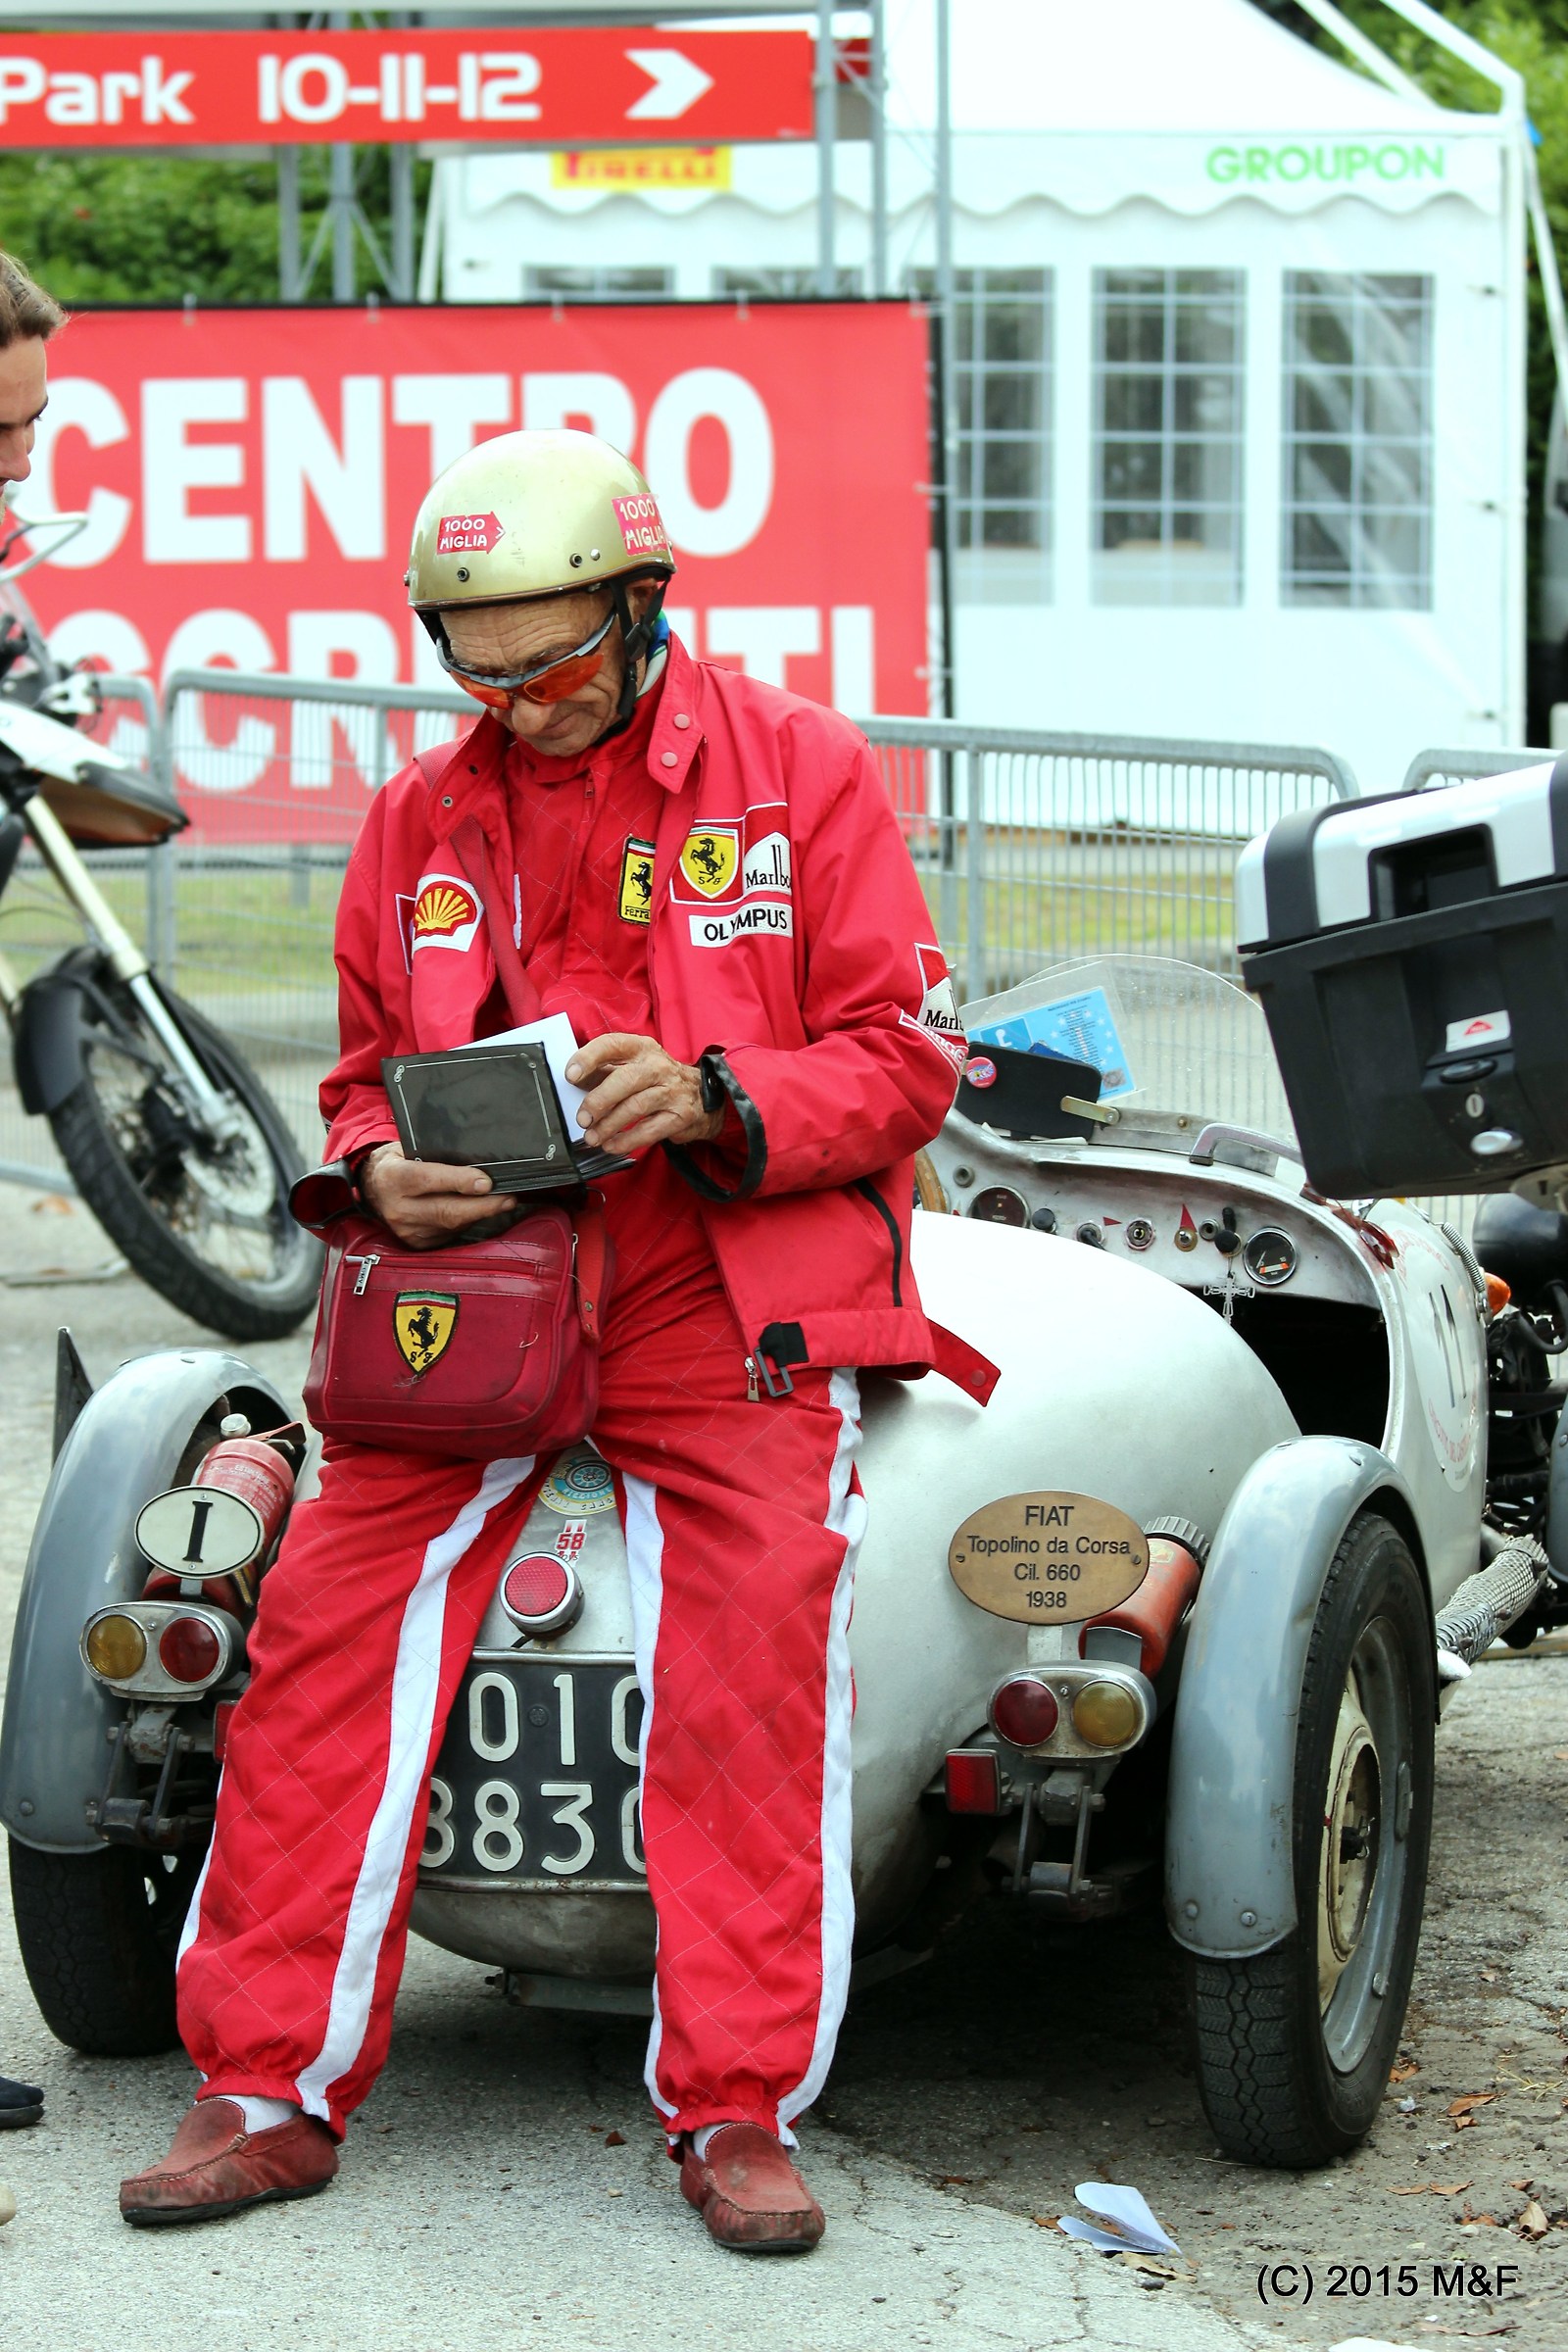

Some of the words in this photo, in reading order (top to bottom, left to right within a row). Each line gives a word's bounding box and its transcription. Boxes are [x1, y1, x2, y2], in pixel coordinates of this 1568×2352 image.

[0, 56, 195, 125] Park
[258, 53, 542, 123] 10-11-12
[1205, 144, 1445, 183] GROUPON
[619, 497, 656, 521] 1000
[444, 517, 486, 532] 1000
[439, 534, 488, 551] MIGLIA
[704, 907, 788, 942] OLYMPUS
[1024, 1504, 1075, 1527] FIAT
[556, 1532, 586, 1550] 58
[966, 1535, 1040, 1557] Topolino
[1046, 1536, 1069, 1554] da
[1075, 1536, 1131, 1554] Corsa
[1013, 1562, 1040, 1581] Cil.
[1046, 1564, 1081, 1581] 660
[1025, 1591, 1067, 1608] 1938
